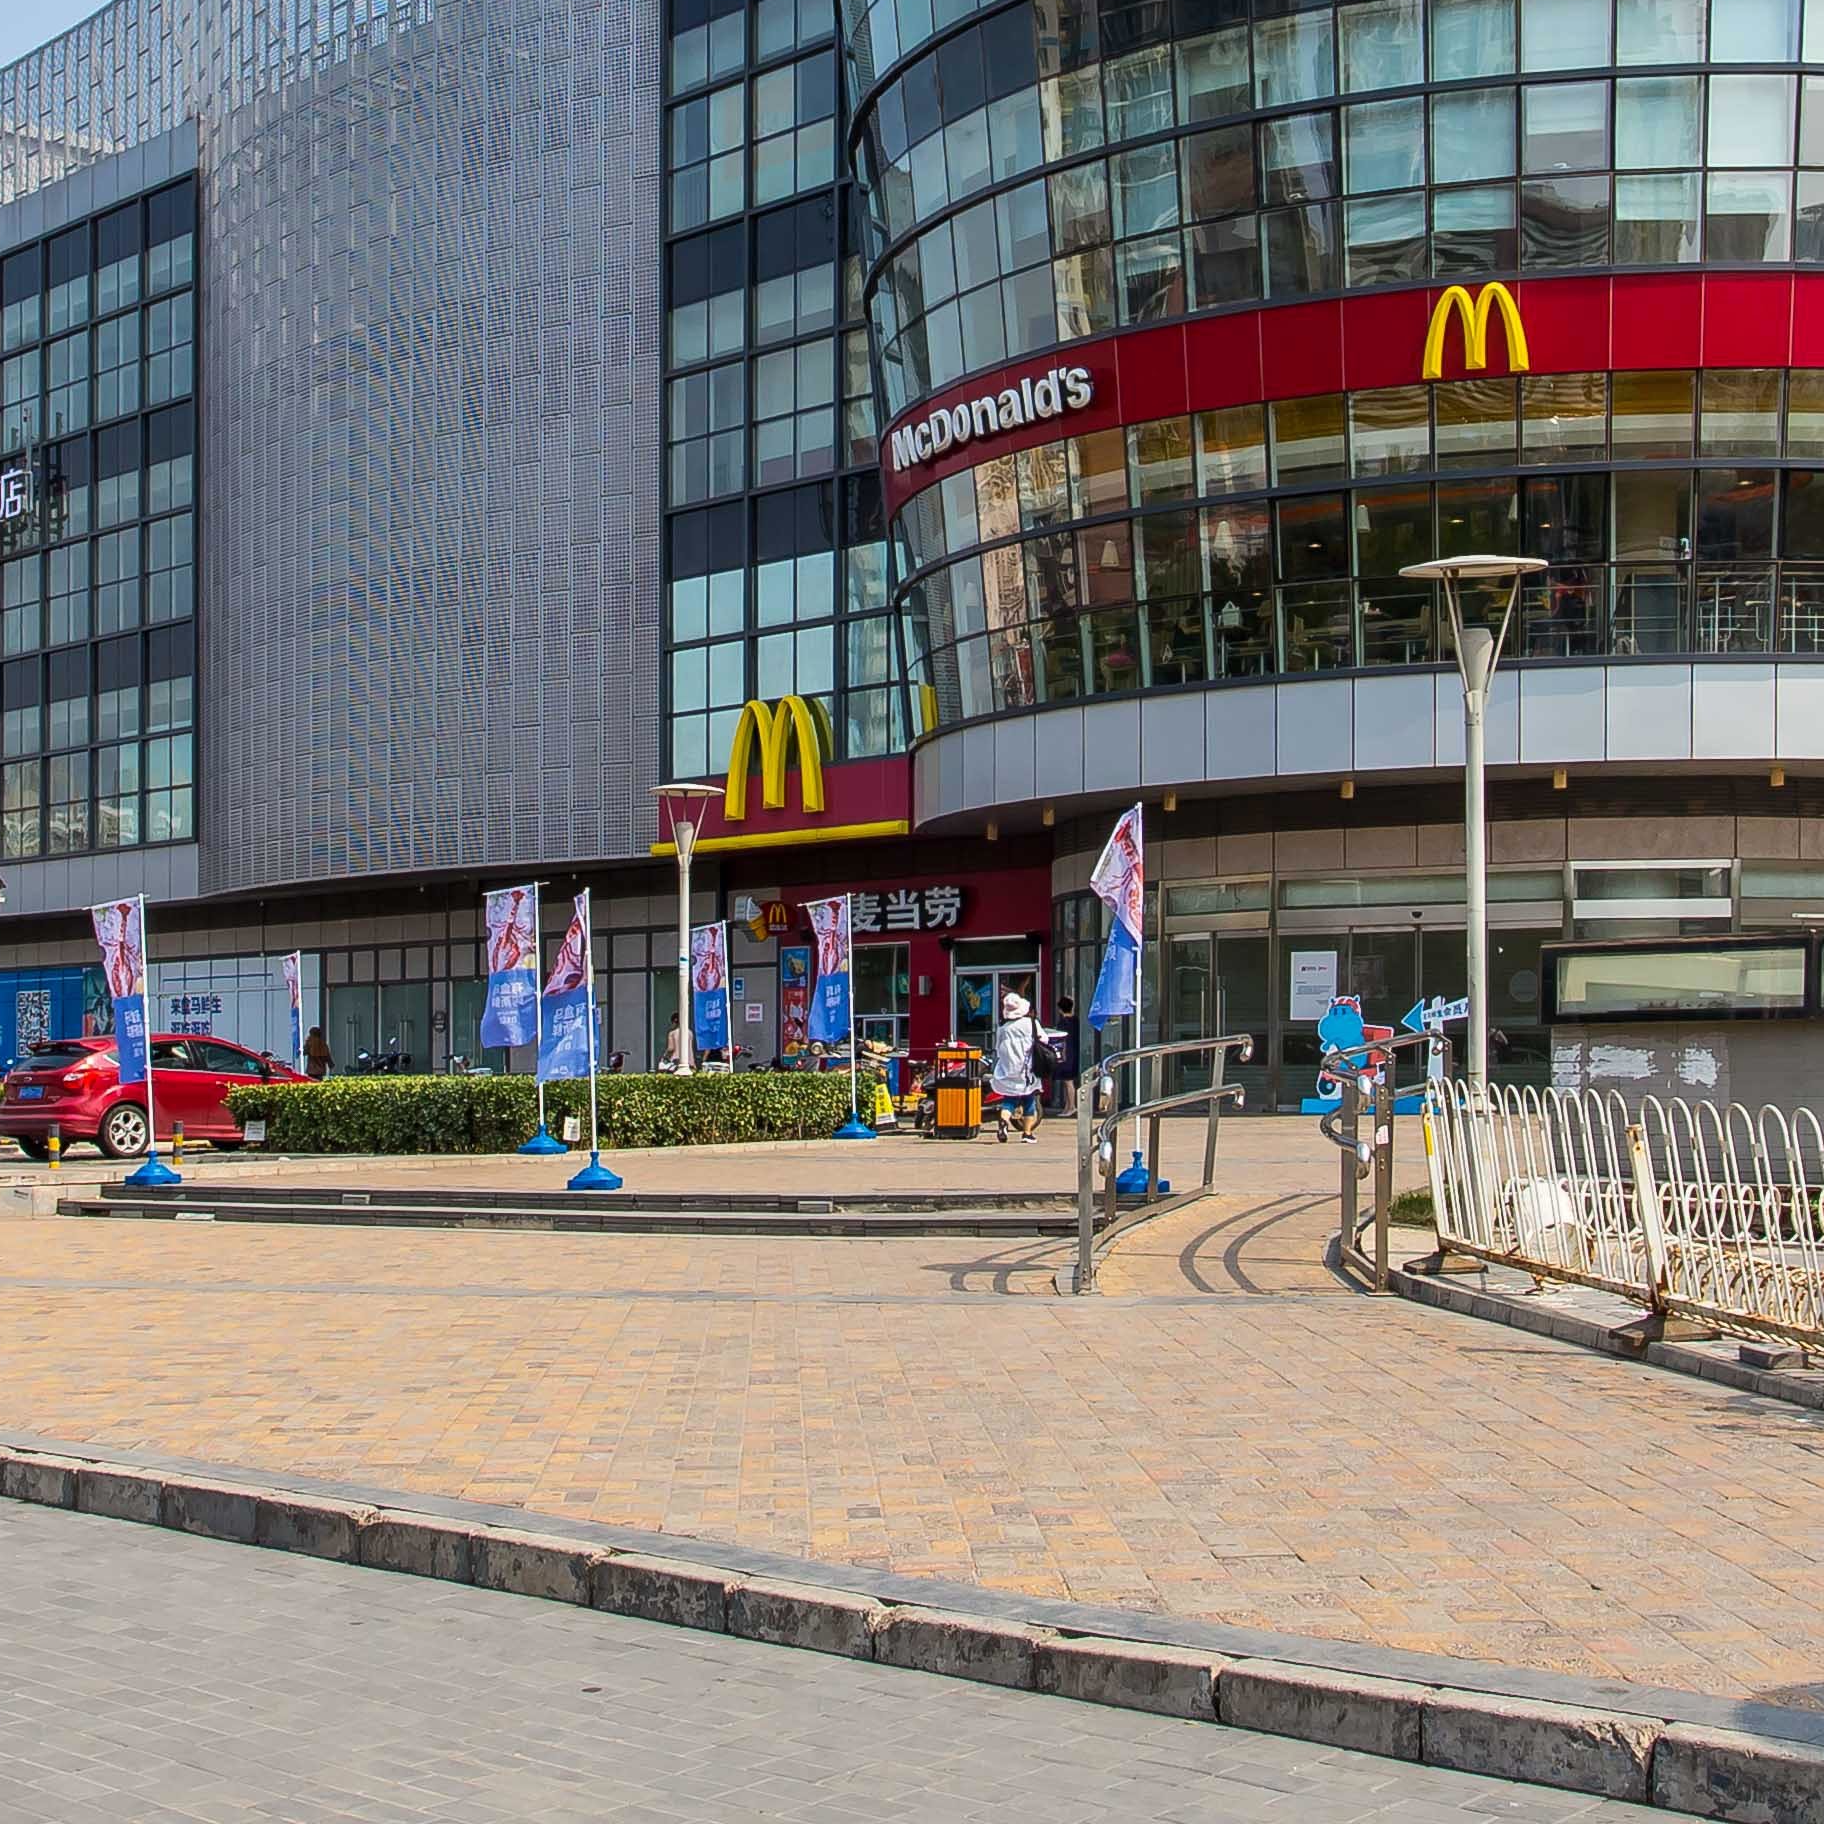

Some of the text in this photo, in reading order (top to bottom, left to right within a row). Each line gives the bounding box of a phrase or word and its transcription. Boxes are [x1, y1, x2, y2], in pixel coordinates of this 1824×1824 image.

[891, 366, 1093, 472] McDonald's
[851, 886, 961, 933] 麦当劳
